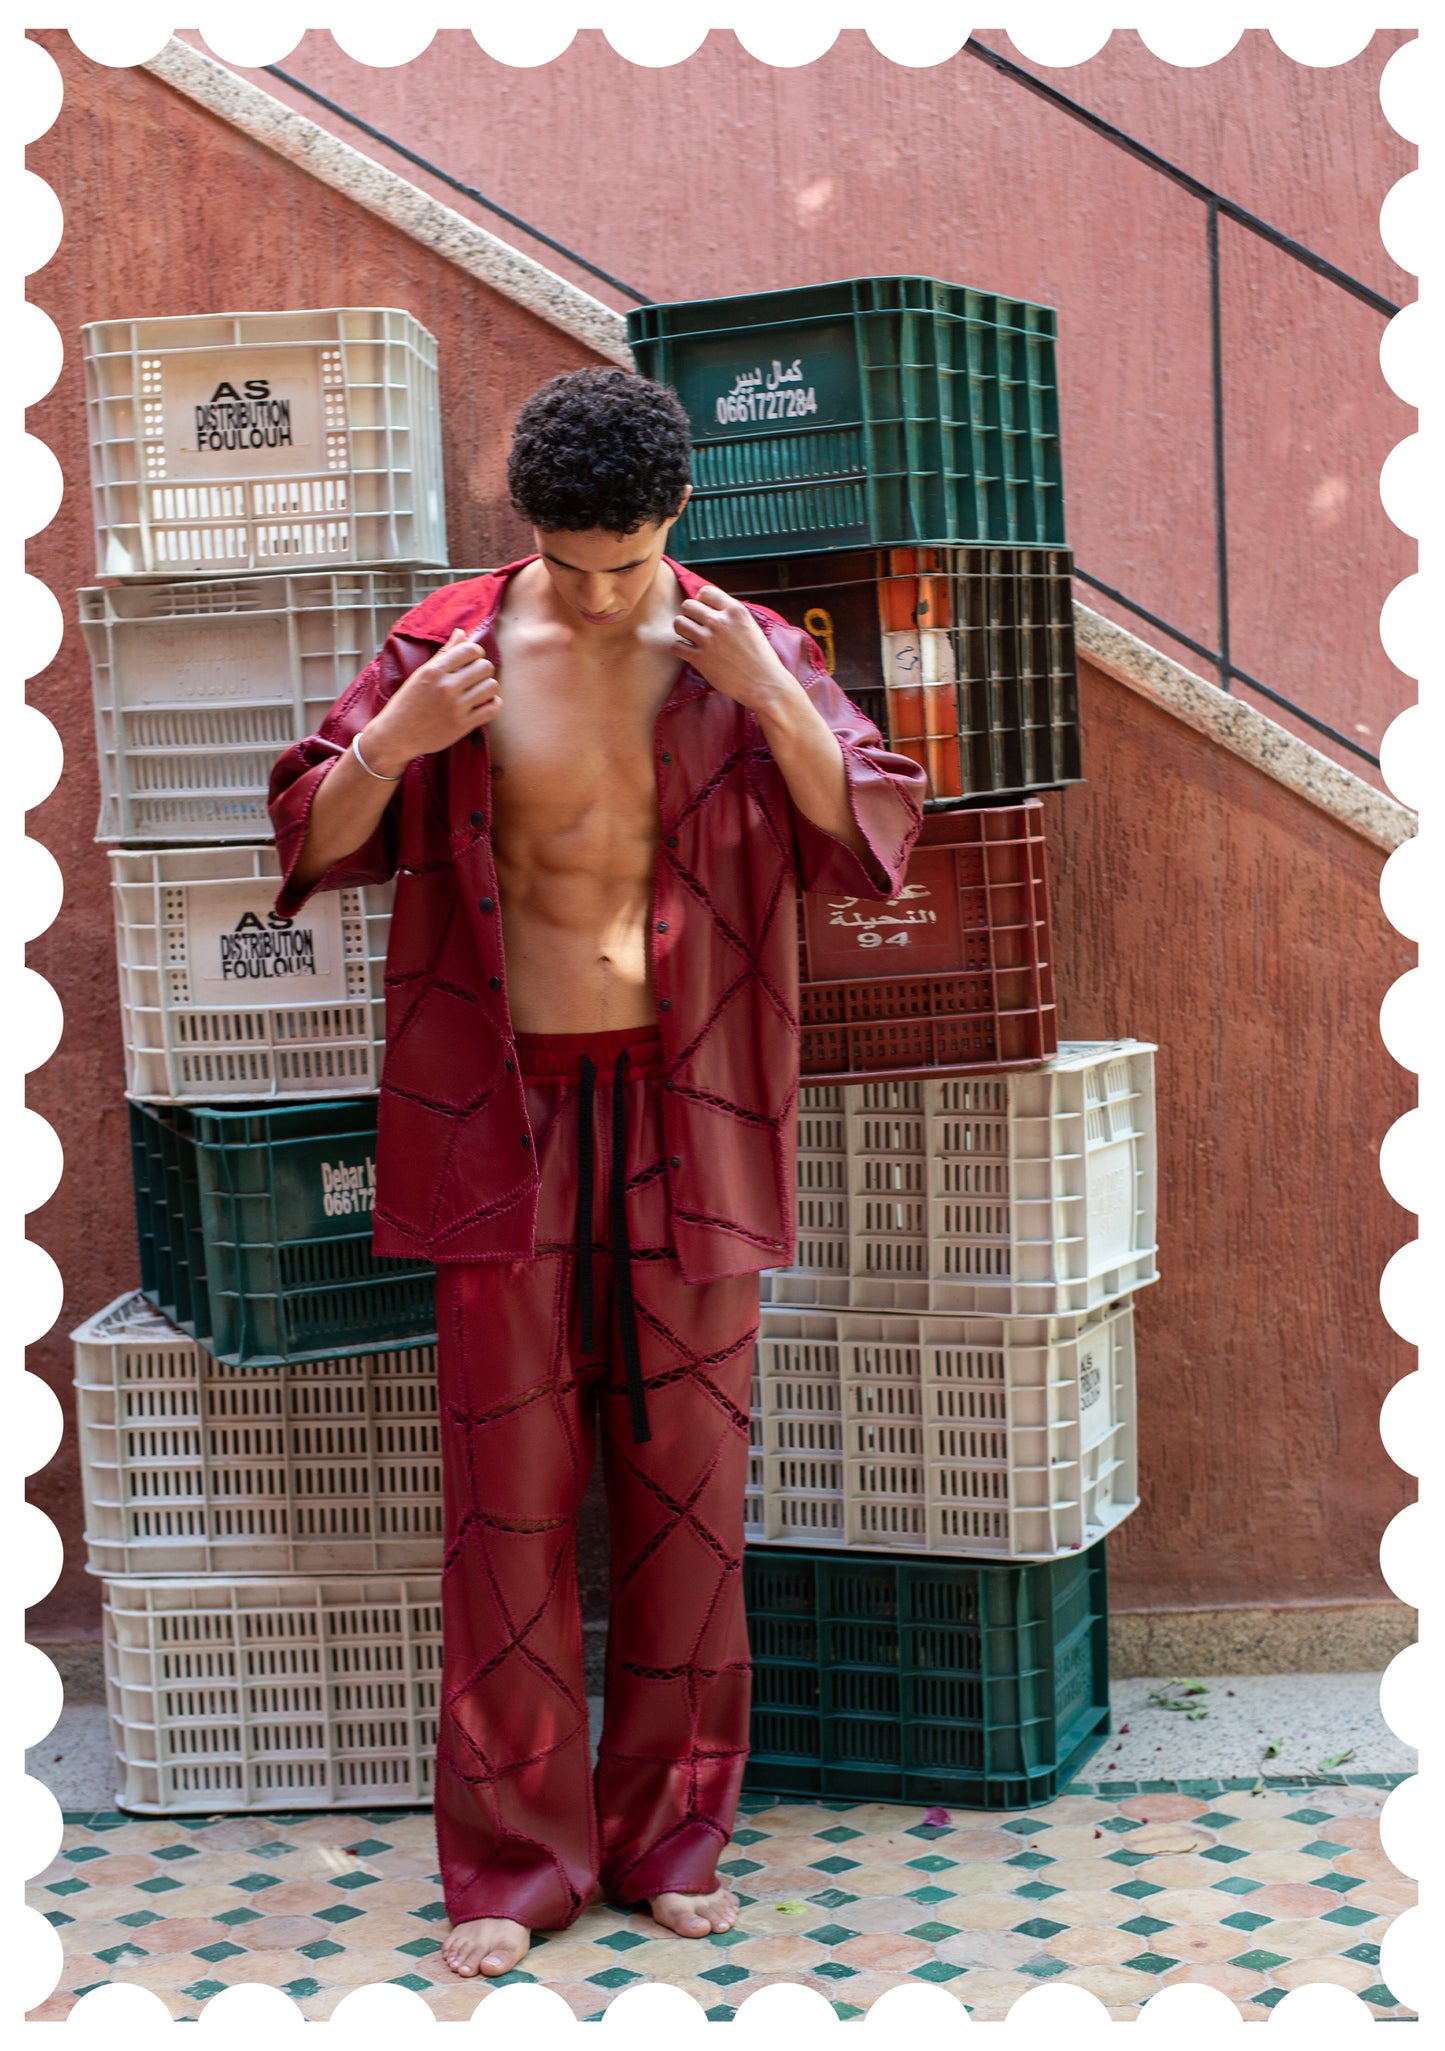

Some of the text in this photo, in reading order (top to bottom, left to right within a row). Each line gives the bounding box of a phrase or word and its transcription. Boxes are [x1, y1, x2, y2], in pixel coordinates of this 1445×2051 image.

[210, 379, 271, 402] AS
[195, 399, 291, 432] DISTRIBUTION
[715, 386, 818, 425] 0661727284
[197, 428, 293, 452] FOULOUH
[235, 910, 294, 932] AS
[220, 929, 314, 960] DISTRIBUTION
[857, 931, 912, 948] 94
[222, 956, 316, 980] FOULOUH
[320, 1160, 364, 1193] Debar
[323, 1187, 376, 1217] 066172
